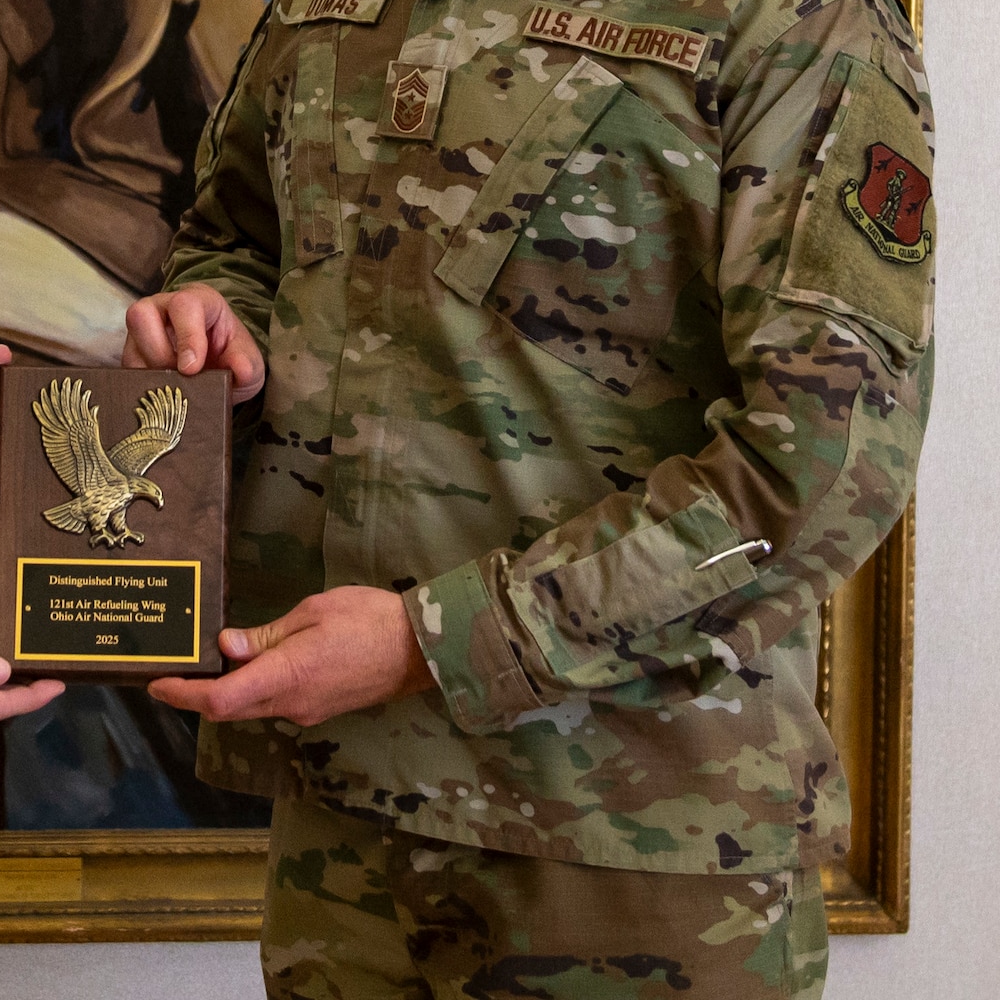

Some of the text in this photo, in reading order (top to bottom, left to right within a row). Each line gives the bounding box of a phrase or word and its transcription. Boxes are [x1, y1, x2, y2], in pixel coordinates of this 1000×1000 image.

[530, 7, 700, 66] U.S. AIR FORCE
[849, 206, 864, 222] AIR
[898, 248, 920, 258] GUARD
[49, 575, 168, 588] Distinguished Flying Unit
[50, 599, 166, 612] 121st Air Refueling Wing
[50, 611, 163, 622] Ohio Air National Guard
[95, 635, 119, 645] 2025
